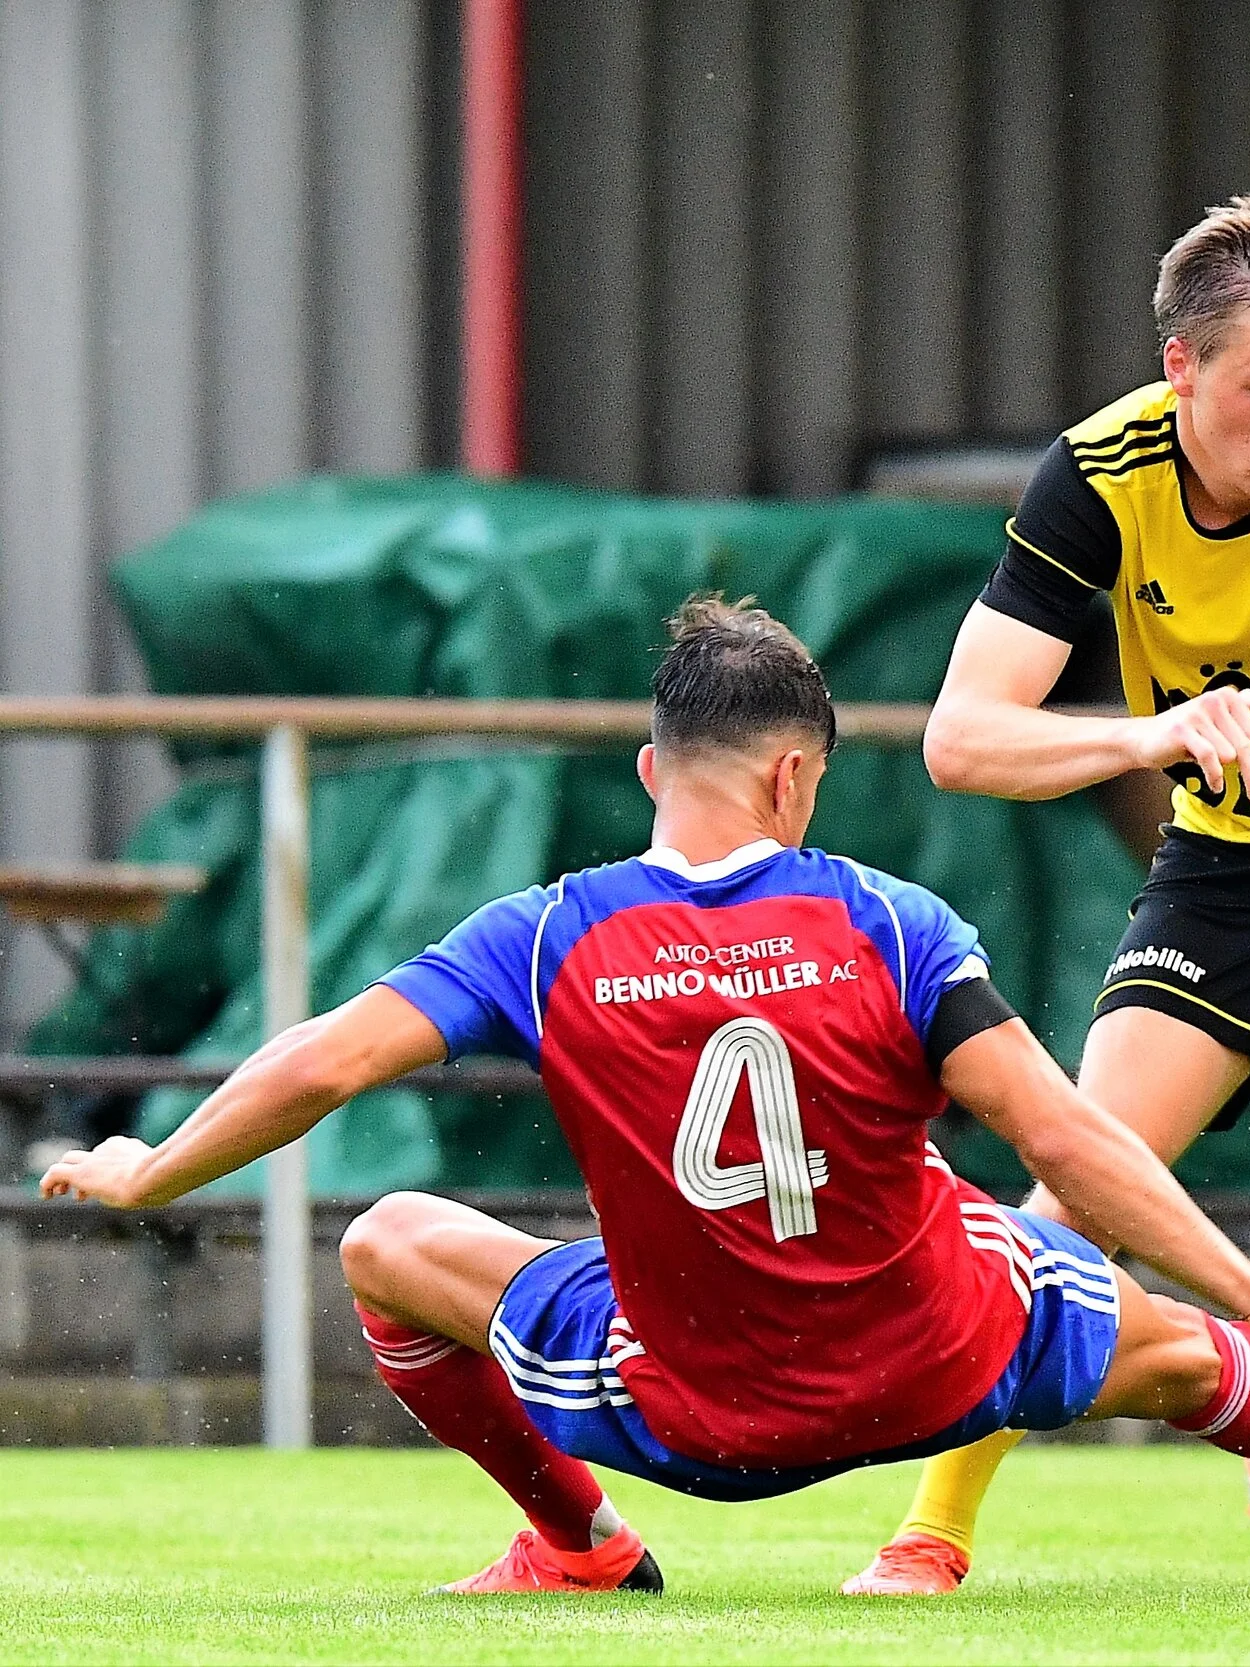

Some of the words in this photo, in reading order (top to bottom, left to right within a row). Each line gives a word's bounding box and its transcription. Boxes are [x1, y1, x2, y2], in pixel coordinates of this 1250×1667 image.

[654, 936, 796, 967] AUTO-CENTER
[594, 968, 706, 1004] BENNO
[707, 960, 823, 1001] MÜLLER
[672, 1016, 830, 1244] 4
